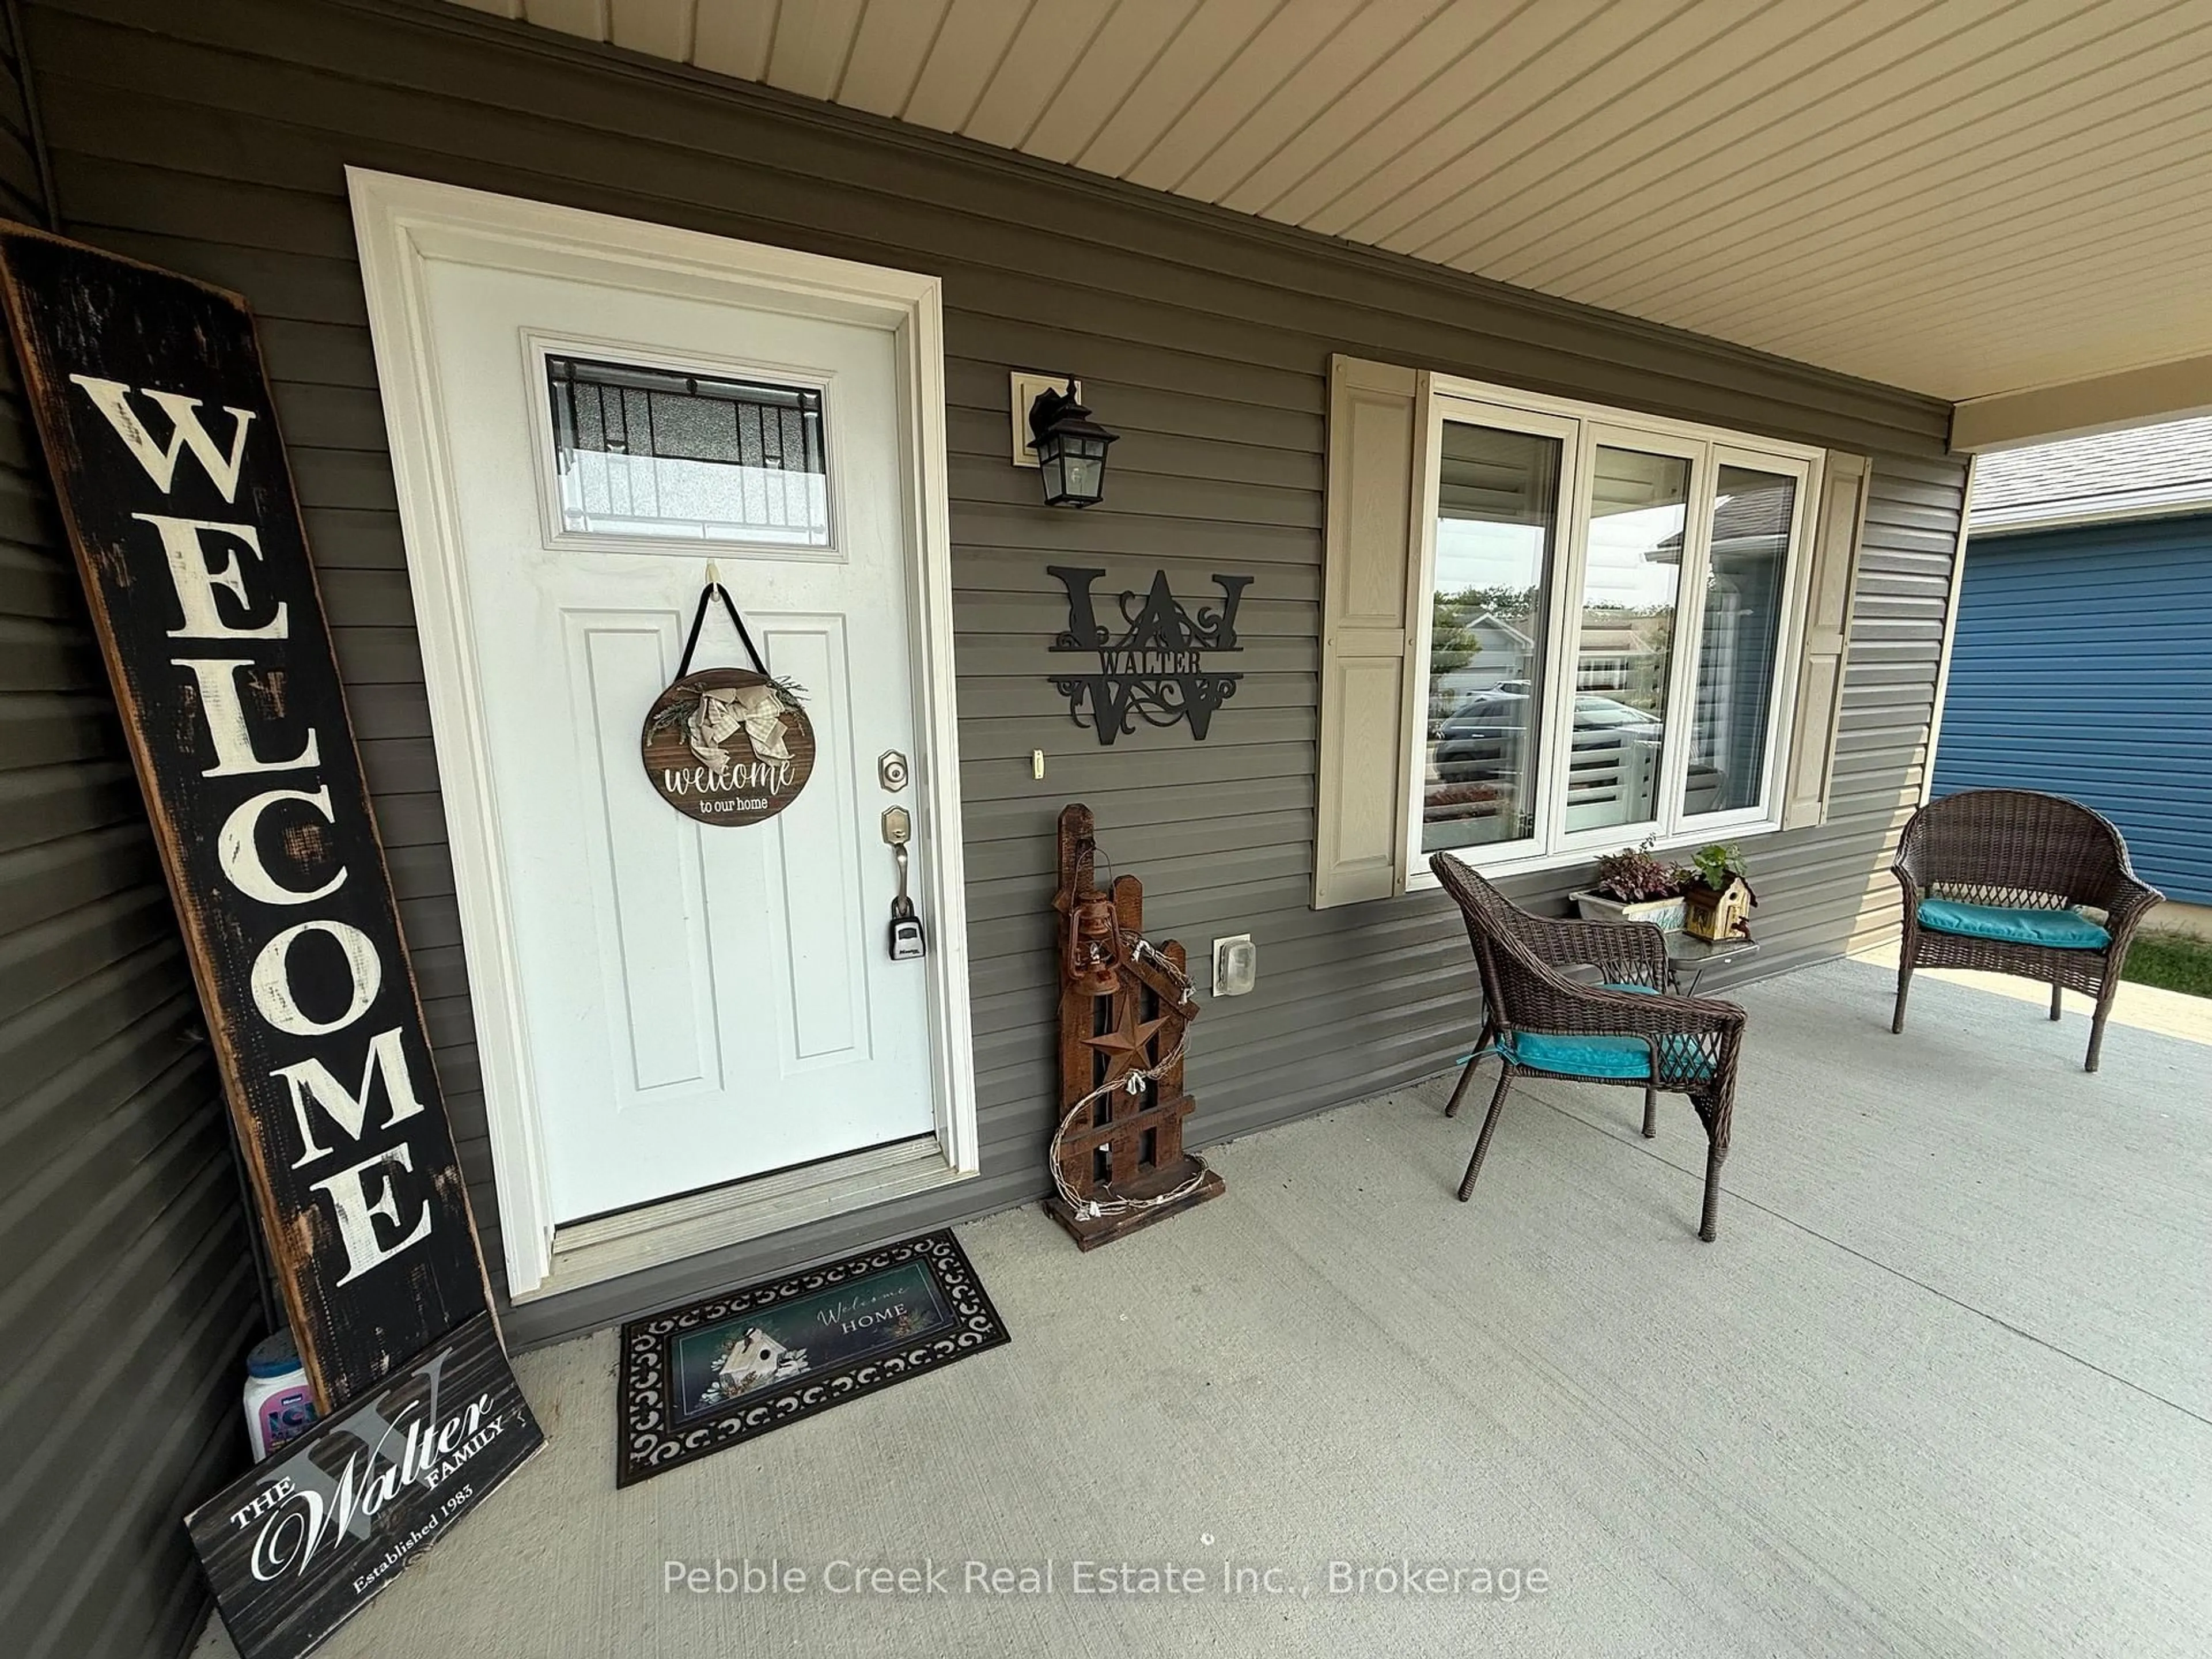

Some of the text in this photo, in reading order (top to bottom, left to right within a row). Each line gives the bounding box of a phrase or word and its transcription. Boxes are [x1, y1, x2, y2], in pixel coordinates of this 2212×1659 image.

[69, 373, 432, 1288] WELCOME
[700, 797, 768, 813] to our home
[842, 1303, 907, 1334] HOME
[251, 1393, 494, 1582] Walter
[425, 1415, 505, 1492] FAMILY
[230, 1476, 296, 1530] THE
[352, 1483, 474, 1594] Established 1983
